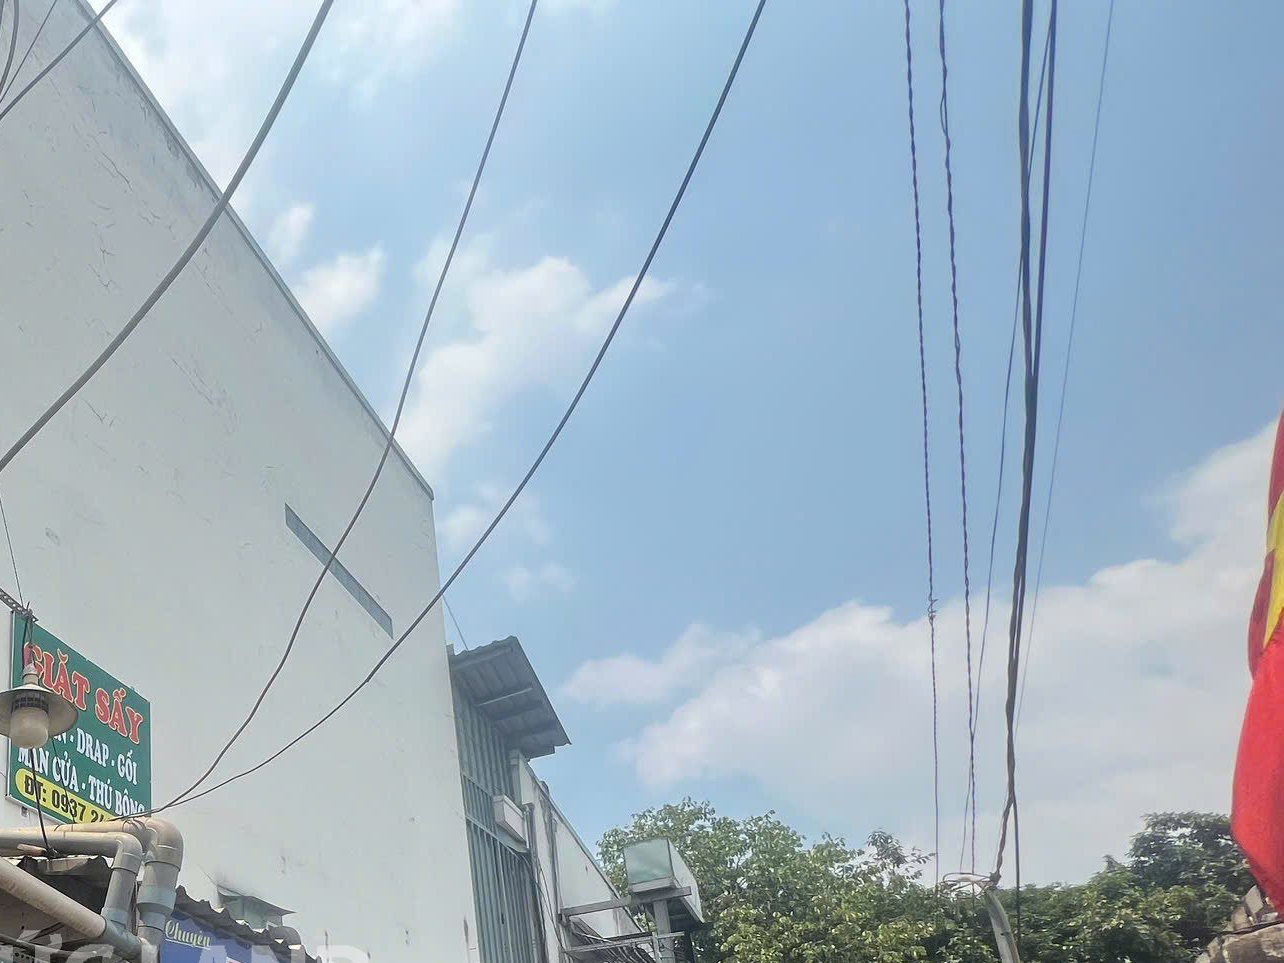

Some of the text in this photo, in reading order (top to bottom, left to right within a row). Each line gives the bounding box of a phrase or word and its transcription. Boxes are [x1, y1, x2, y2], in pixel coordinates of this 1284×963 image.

[95, 688, 144, 745] SẤY
[52, 751, 79, 792] CỬA
[89, 774, 112, 810] THÚ
[77, 728, 138, 785] DRAP GỐI
[52, 789, 86, 821] 0937
